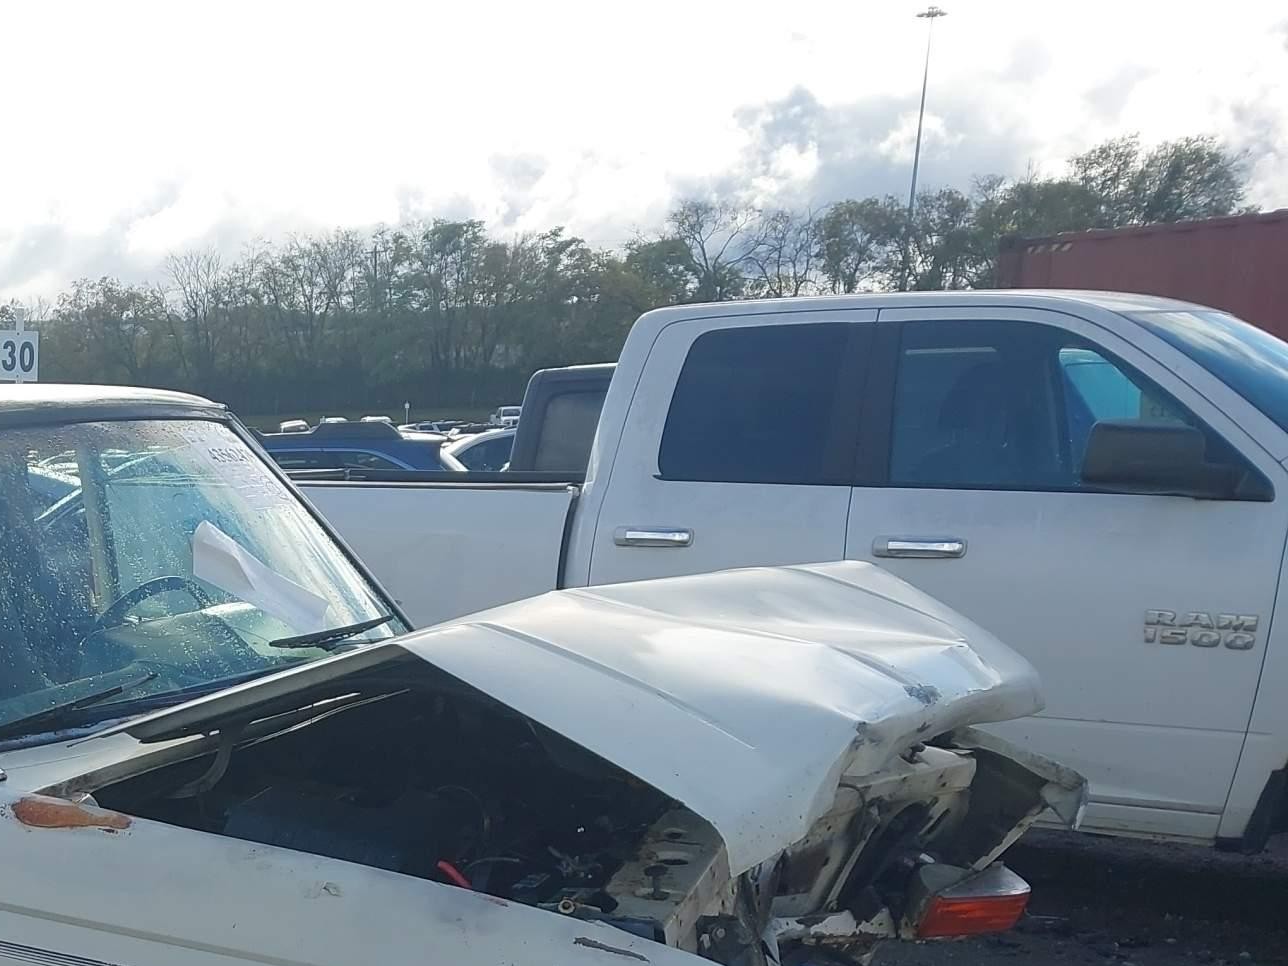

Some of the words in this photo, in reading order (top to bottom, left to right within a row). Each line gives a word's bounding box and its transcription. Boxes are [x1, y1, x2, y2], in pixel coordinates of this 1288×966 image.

[1, 340, 35, 373] 30
[1144, 609, 1259, 632] RAM
[1143, 627, 1256, 651] 1500
